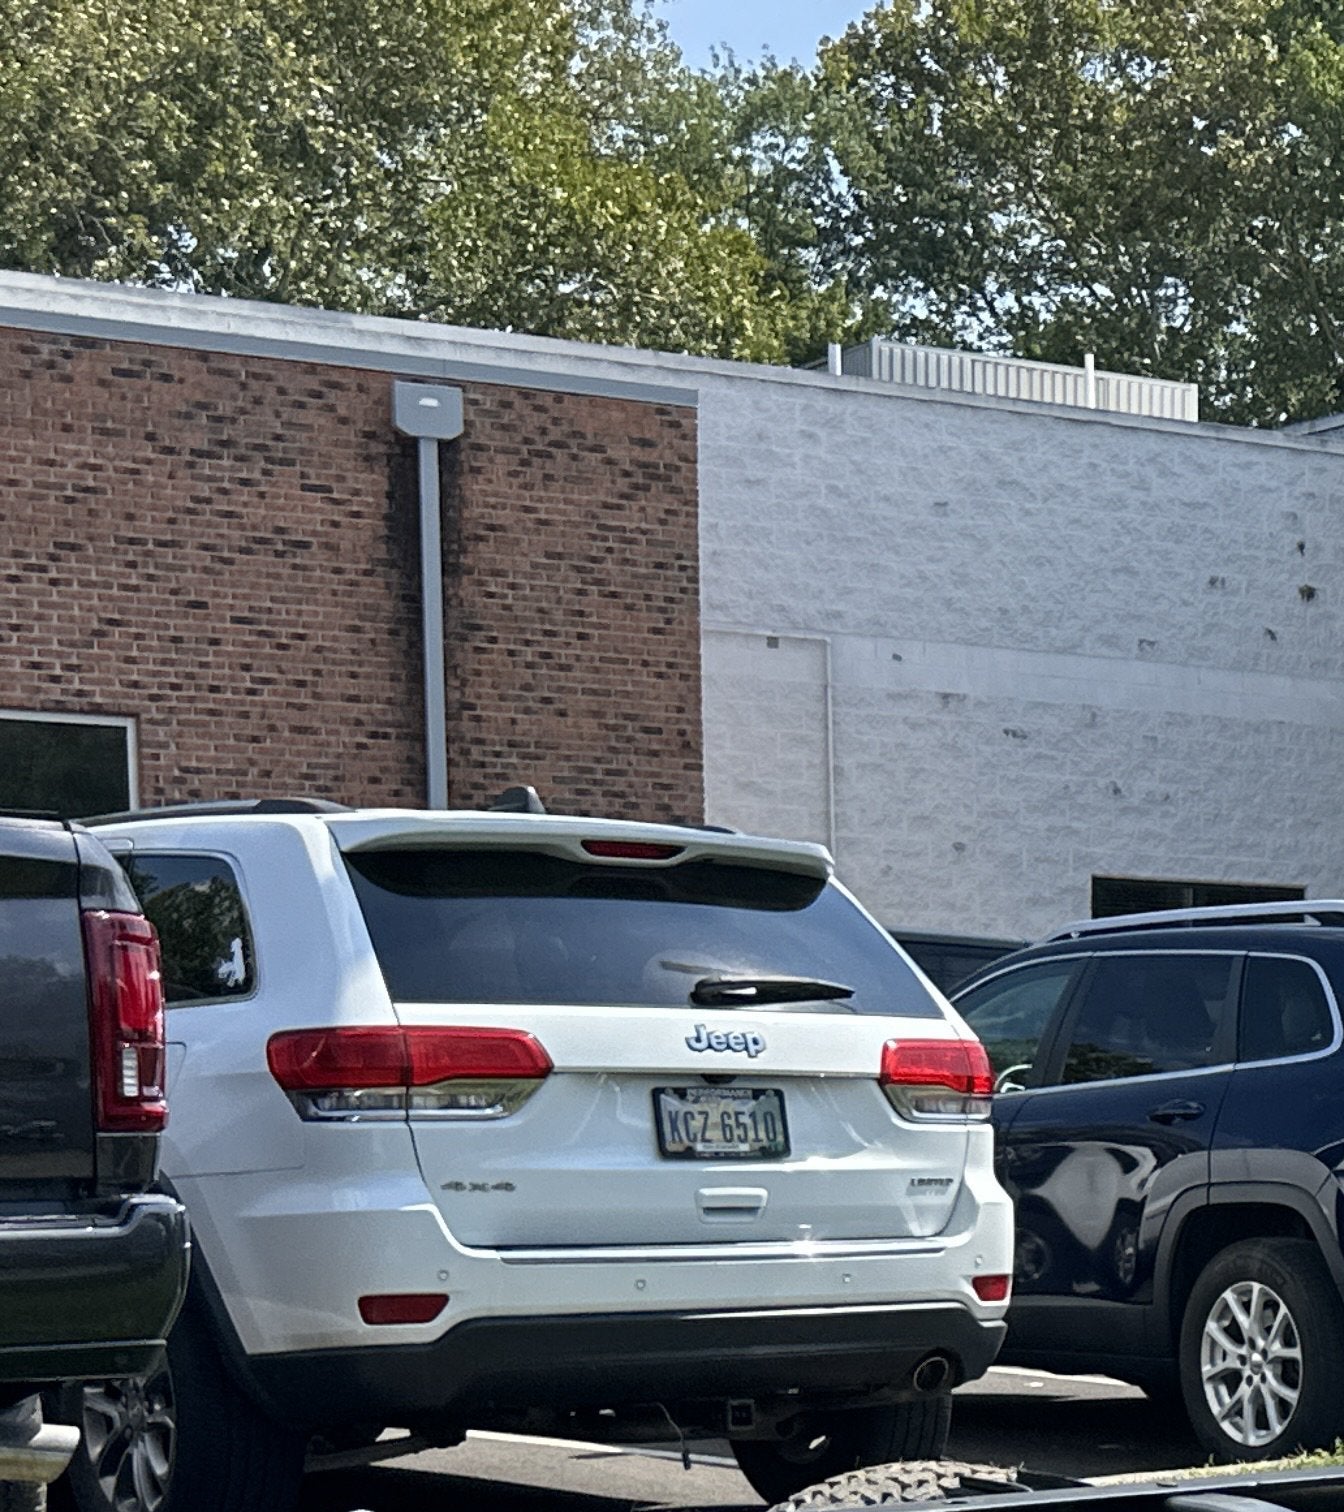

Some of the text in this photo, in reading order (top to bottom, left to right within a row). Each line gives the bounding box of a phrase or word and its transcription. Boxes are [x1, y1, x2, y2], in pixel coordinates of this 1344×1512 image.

[685, 1024, 766, 1058] Jeep
[668, 1110, 777, 1144] KCZ 6510
